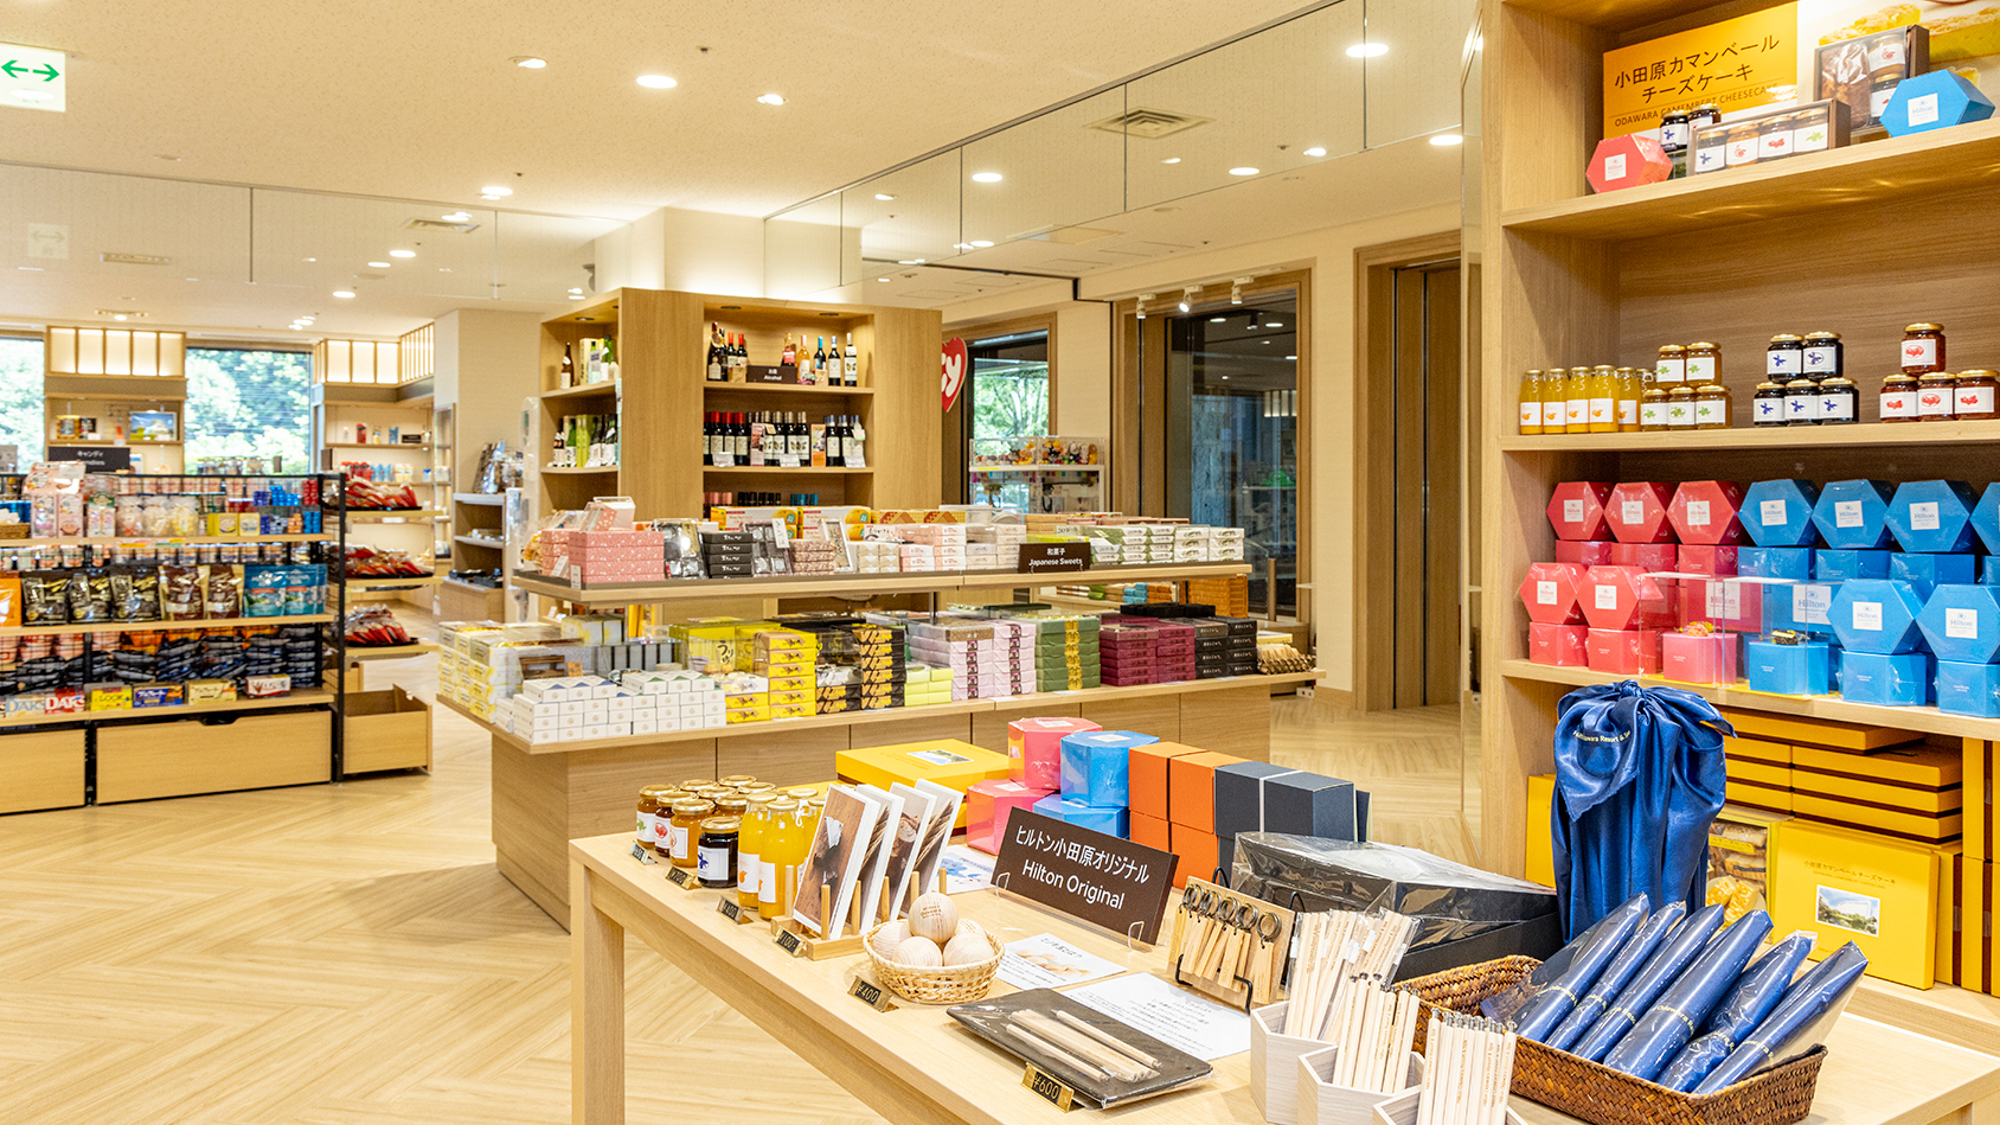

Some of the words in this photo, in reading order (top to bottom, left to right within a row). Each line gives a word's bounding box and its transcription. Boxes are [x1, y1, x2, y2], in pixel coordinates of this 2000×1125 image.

[1614, 34, 1780, 88] 小田原カマンベール
[1641, 63, 1753, 104] チーズケーキ
[1614, 110, 1659, 127] ODAWARA
[76, 450, 104, 458] キャンディ
[1046, 547, 1066, 556] 和菓子
[1028, 558, 1059, 567] Japanese
[1060, 557, 1082, 565] Sweets
[1798, 599, 1826, 608] Hilton
[1950, 619, 1973, 627] Hilton
[45, 696, 84, 710] DARS
[1014, 825, 1151, 884] ヒルトン小田原オリジナル
[1022, 859, 1064, 889] Hilton
[1066, 875, 1126, 910] Original
[856, 982, 880, 1004] ¥400
[1033, 1074, 1060, 1100] ¥600
